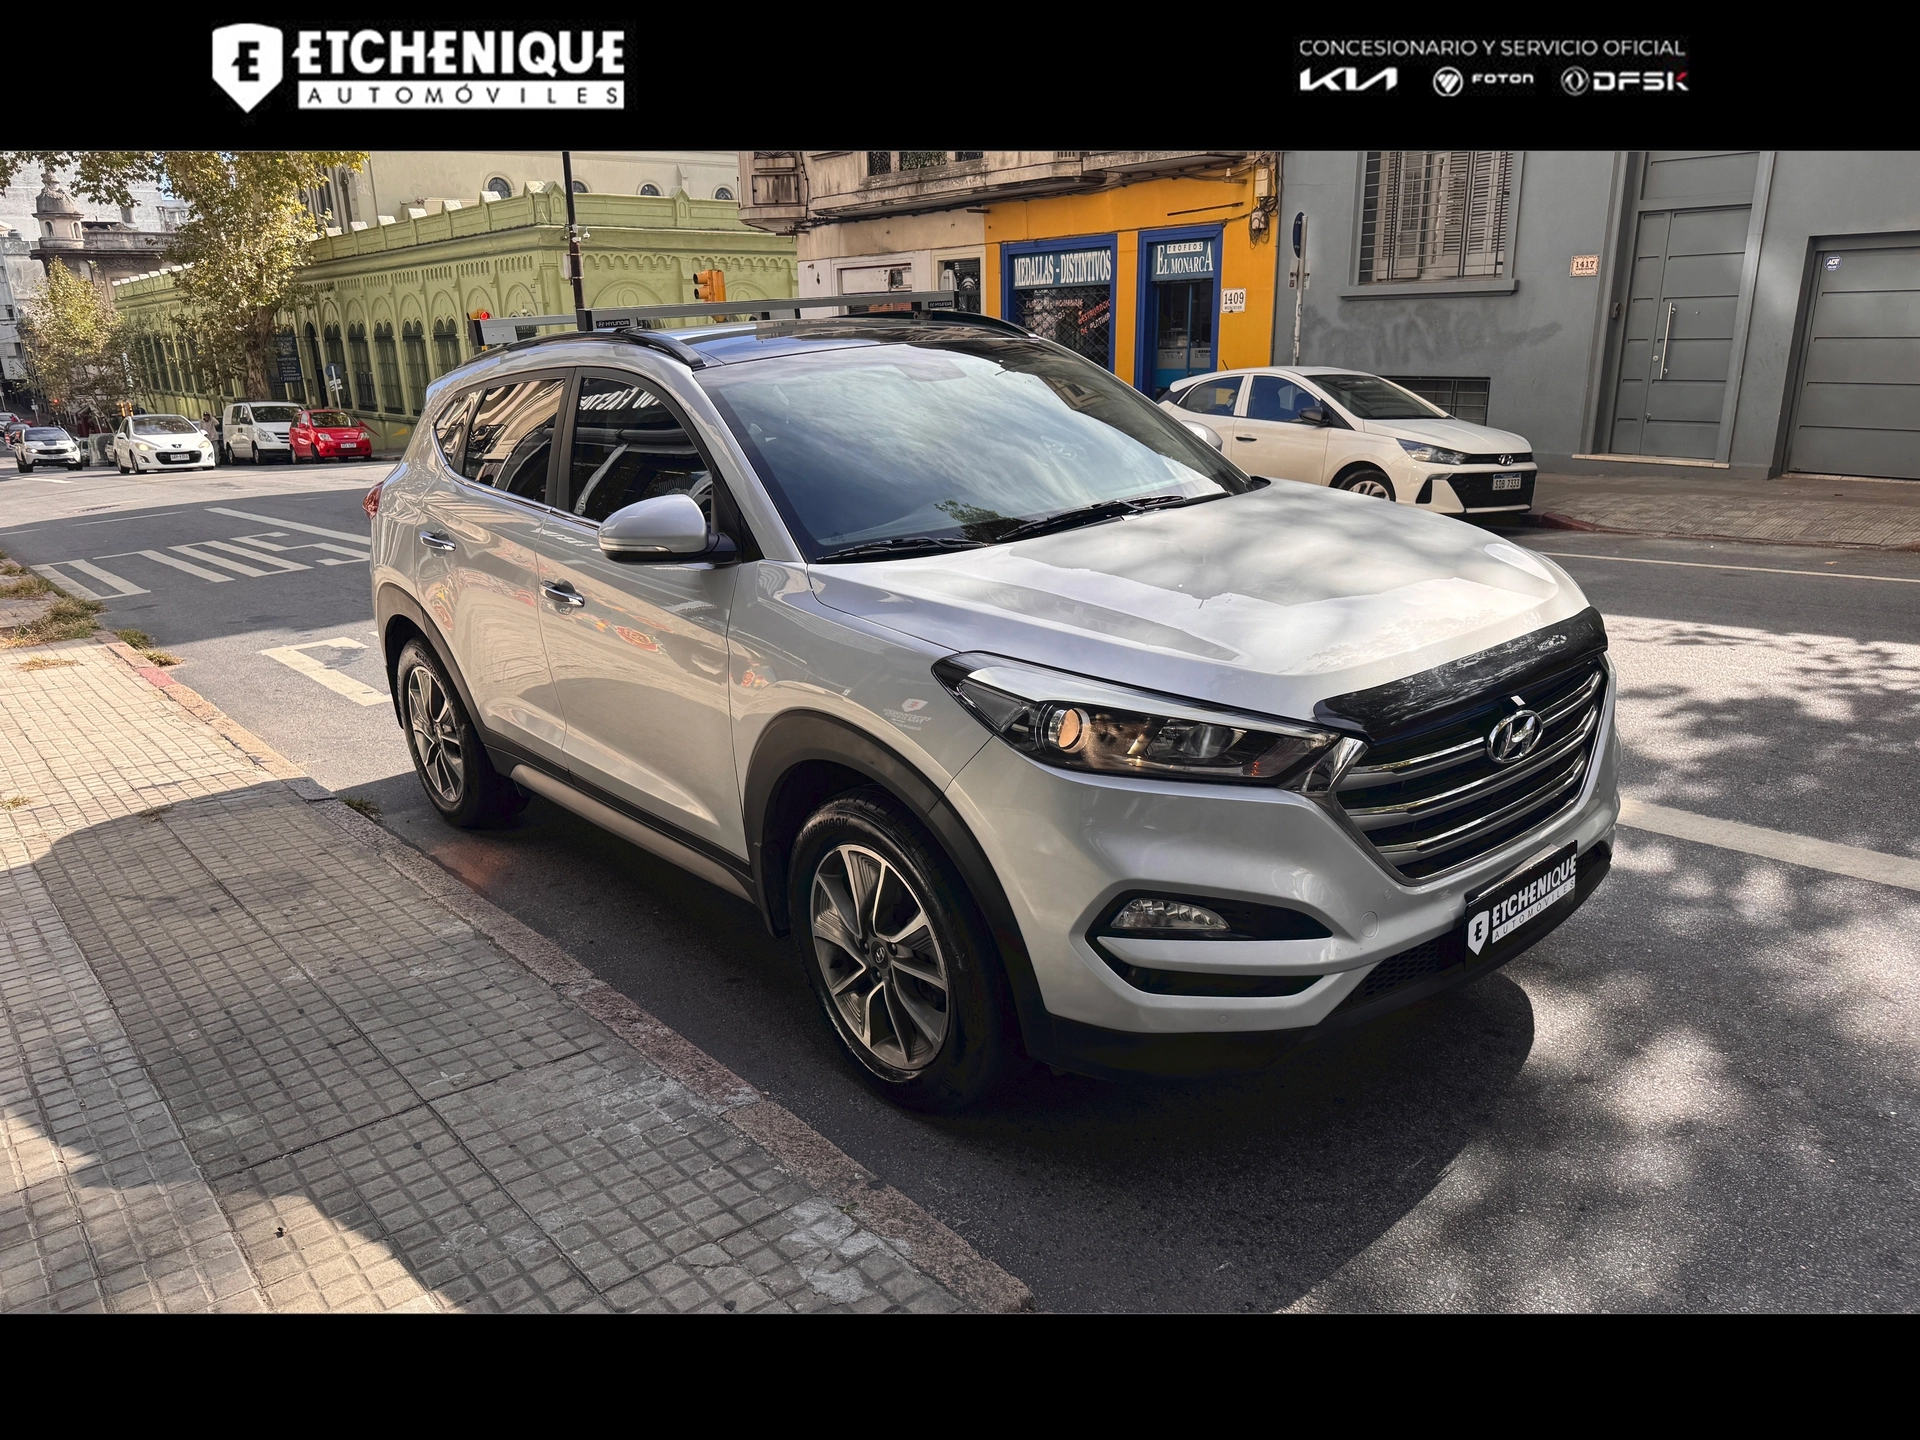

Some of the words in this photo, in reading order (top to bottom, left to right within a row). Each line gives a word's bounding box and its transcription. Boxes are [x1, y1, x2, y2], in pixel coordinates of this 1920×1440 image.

[1168, 243, 1202, 252] TROFEOS
[1014, 254, 1054, 287] MEDALLAS
[1060, 249, 1112, 283] DISTINTIVOS
[1575, 260, 1595, 268] 1417
[1224, 292, 1244, 305] 1409
[1506, 478, 1520, 488] 7333
[1491, 853, 1577, 928] ETCHENIQUE
